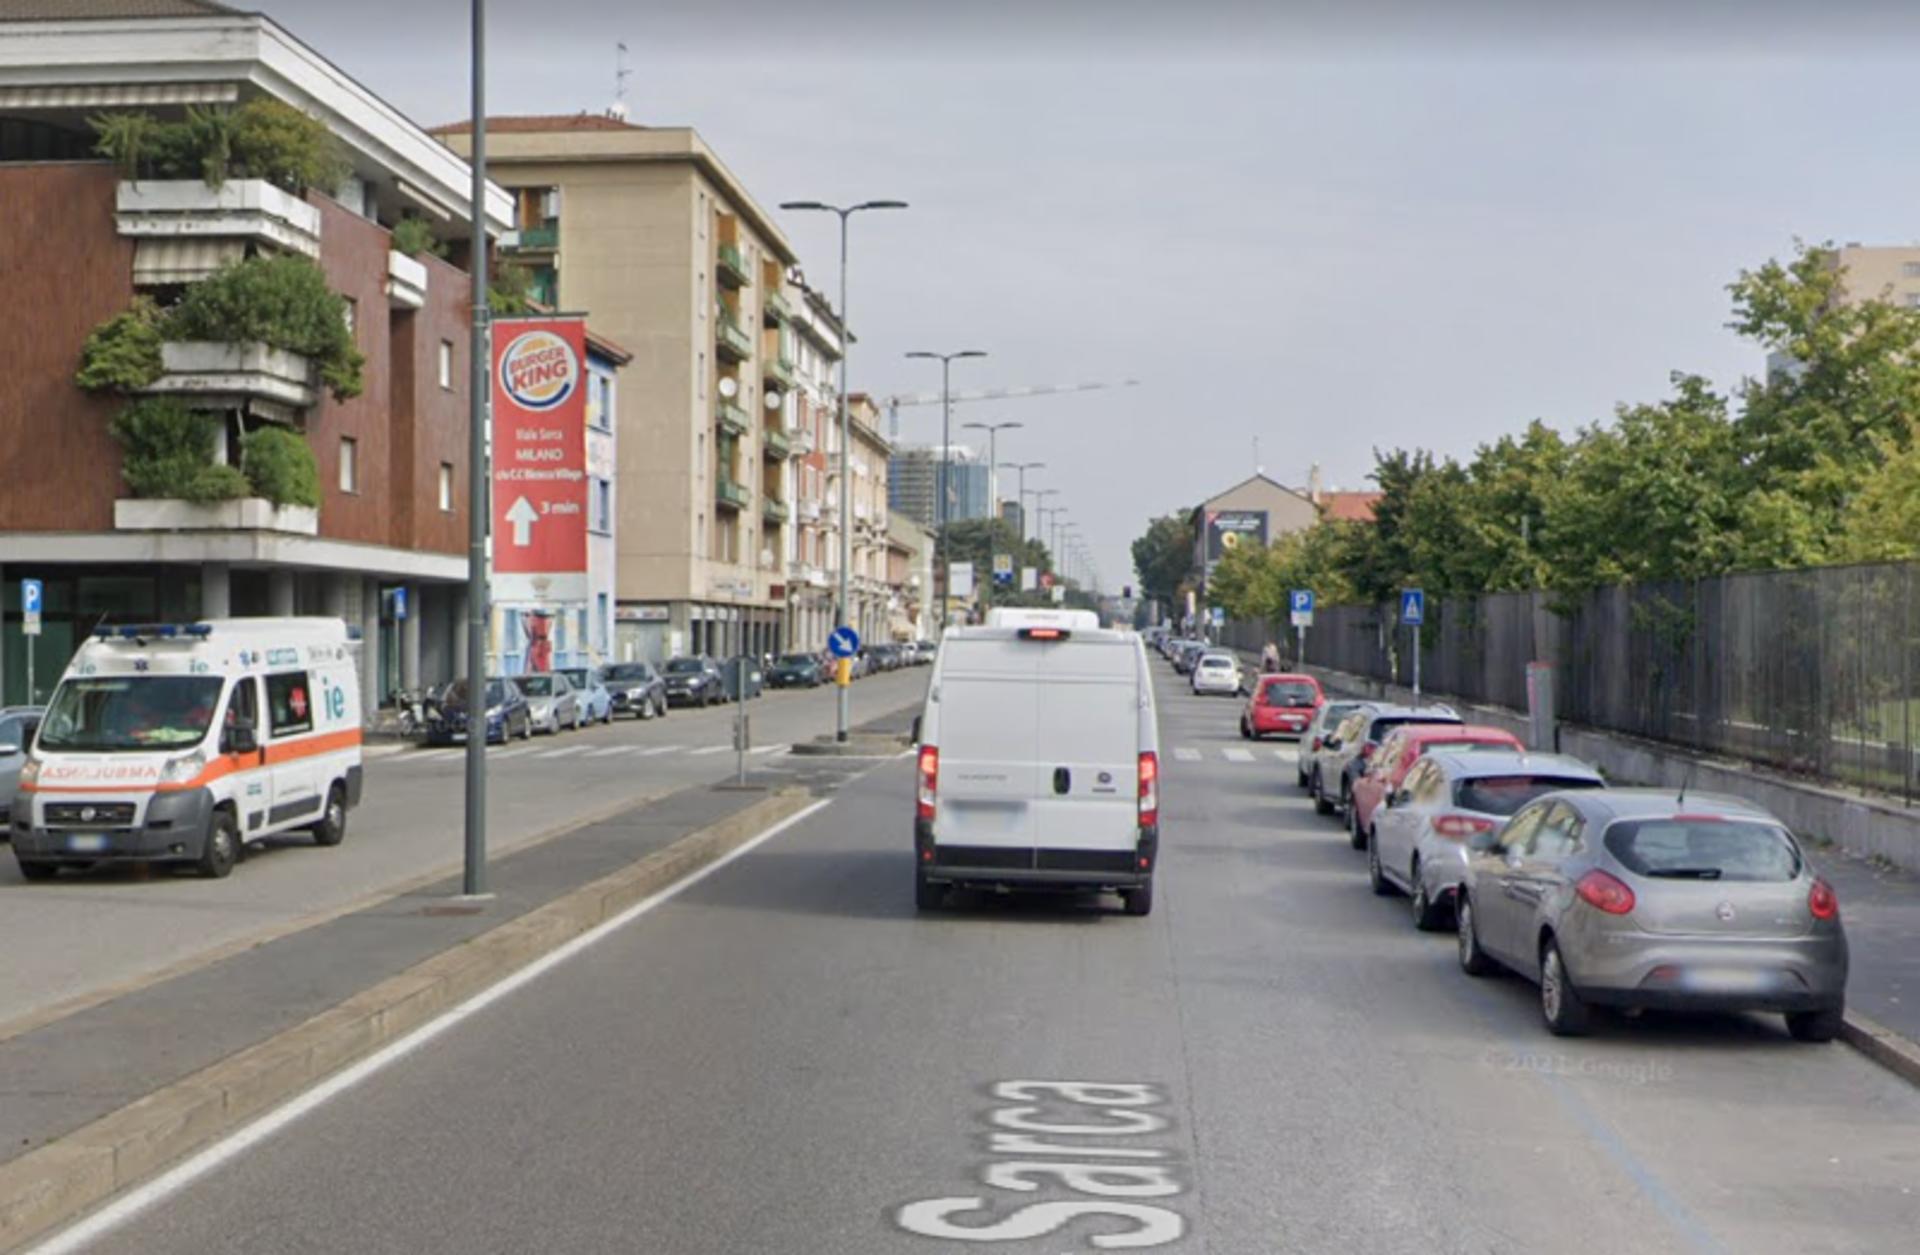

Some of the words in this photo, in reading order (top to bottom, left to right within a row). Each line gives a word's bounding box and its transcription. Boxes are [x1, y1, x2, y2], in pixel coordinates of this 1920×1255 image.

[509, 346, 566, 375] BURGER
[511, 360, 568, 391] KING
[515, 448, 564, 461] MILANO
[540, 501, 550, 514] 3
[551, 501, 580, 514] min
[25, 583, 39, 611] P
[1295, 593, 1309, 611] P
[899, 1079, 1182, 1248] Sarca
